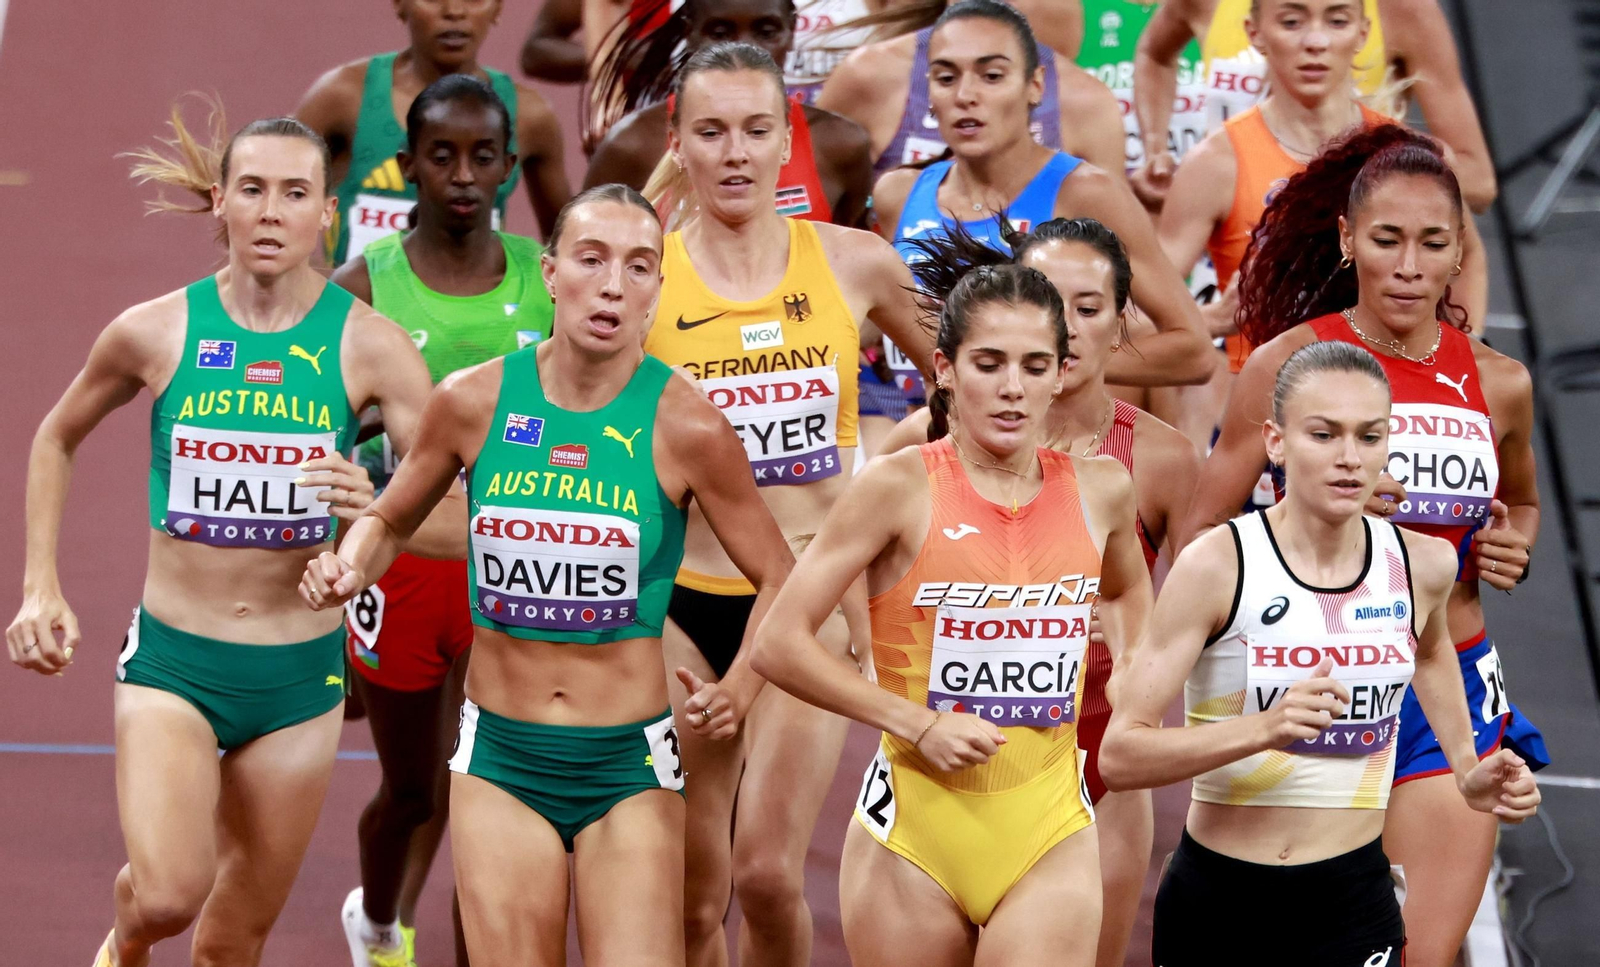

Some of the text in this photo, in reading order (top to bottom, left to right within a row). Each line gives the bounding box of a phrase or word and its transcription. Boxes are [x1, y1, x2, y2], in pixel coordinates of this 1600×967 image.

[743, 327, 781, 343] WGV
[247, 367, 282, 378] CHEMIST
[707, 378, 834, 409] ONDA
[178, 389, 332, 431] AUSTRALIA
[732, 413, 827, 455] YER
[1388, 415, 1489, 442] ONDA
[176, 437, 328, 467] HONDA
[552, 449, 587, 462] CHEMIST
[1384, 451, 1489, 492] CHOA
[193, 476, 308, 515] HALL
[485, 471, 639, 516] AUSTRALIA
[474, 516, 635, 548] HONDA
[483, 552, 627, 598] DAVIES
[912, 573, 1101, 608] ESPAÑA
[351, 589, 378, 633] 8
[1355, 606, 1392, 621] Allianz
[939, 617, 1087, 641] HONDA
[1252, 644, 1410, 669] HONDA
[862, 758, 893, 828] 12
